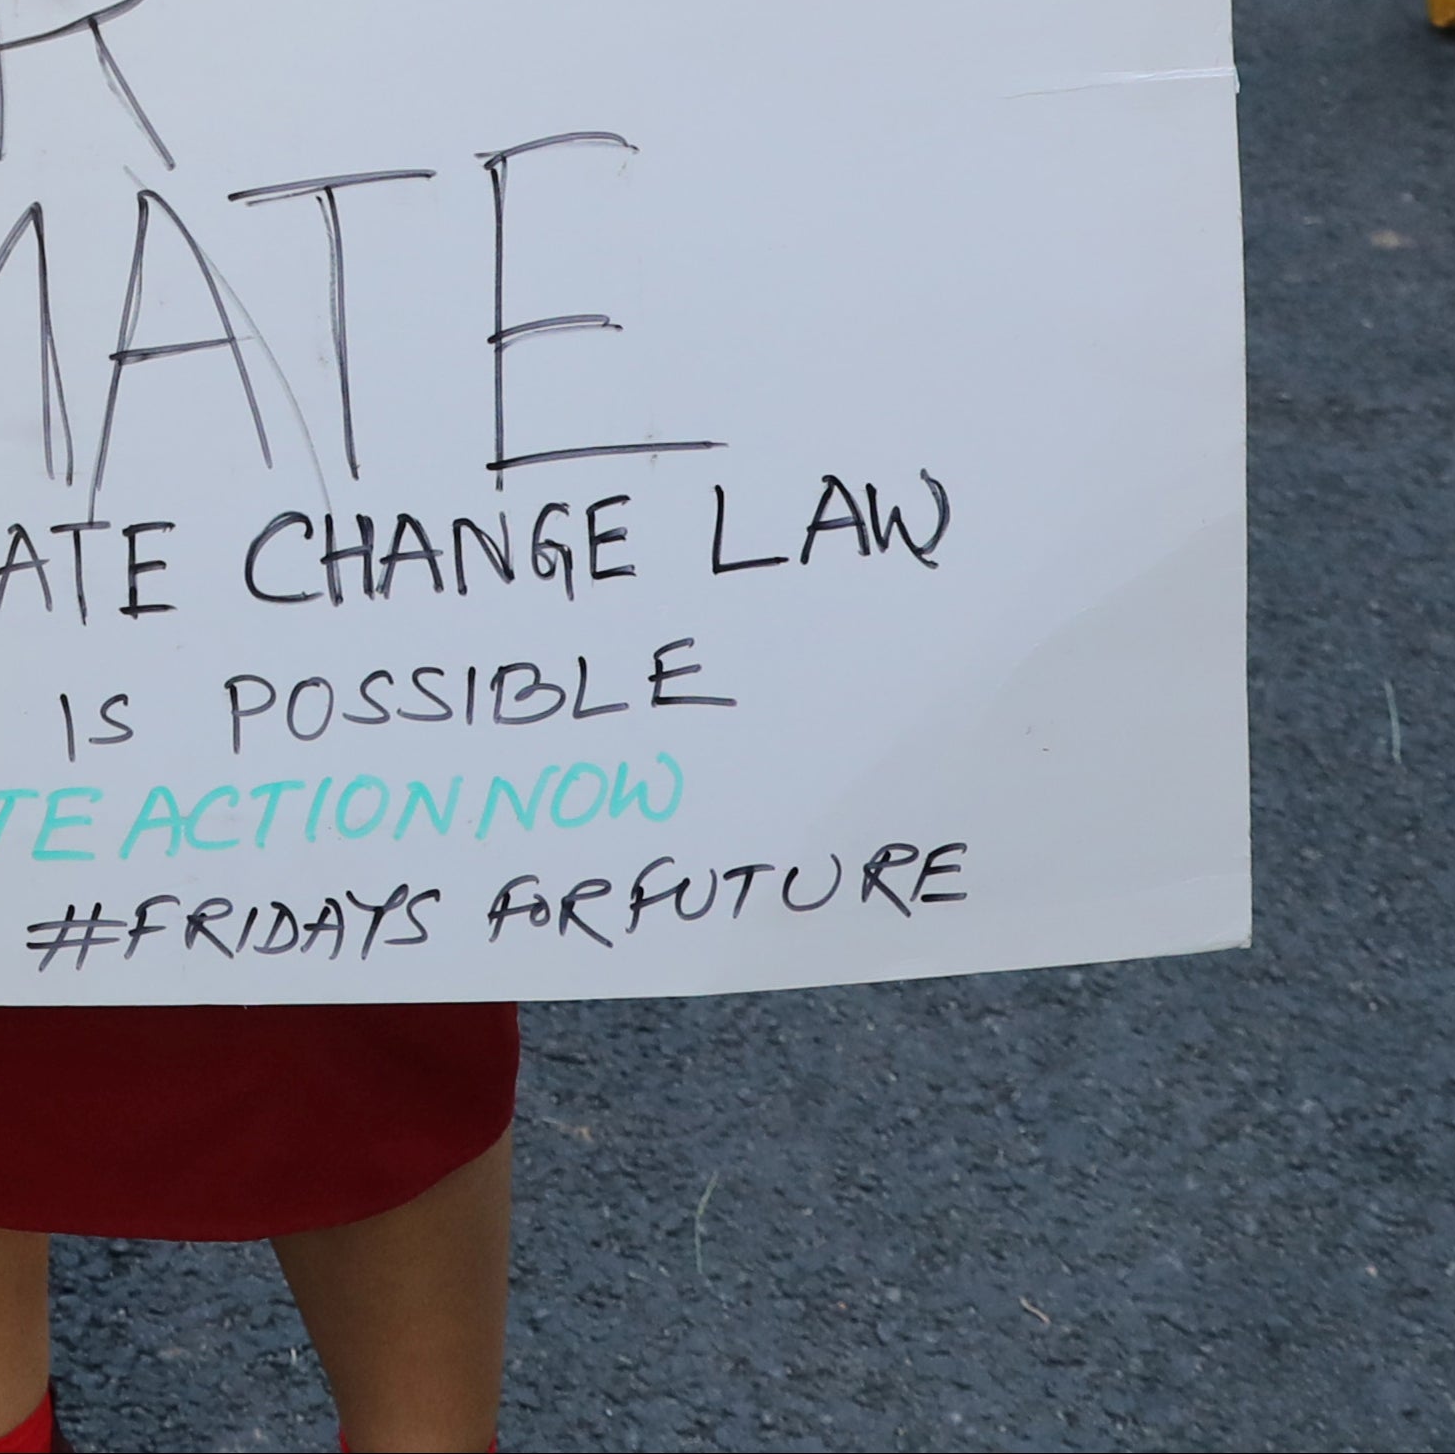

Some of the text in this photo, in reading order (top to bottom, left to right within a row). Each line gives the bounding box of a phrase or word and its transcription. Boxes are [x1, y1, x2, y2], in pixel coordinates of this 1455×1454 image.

[243, 494, 636, 605] CHANGE
[710, 469, 952, 574] LAW
[63, 692, 134, 762] IS
[224, 637, 738, 754] POSSIBLE
[24, 883, 441, 971] #FRIDAYS
